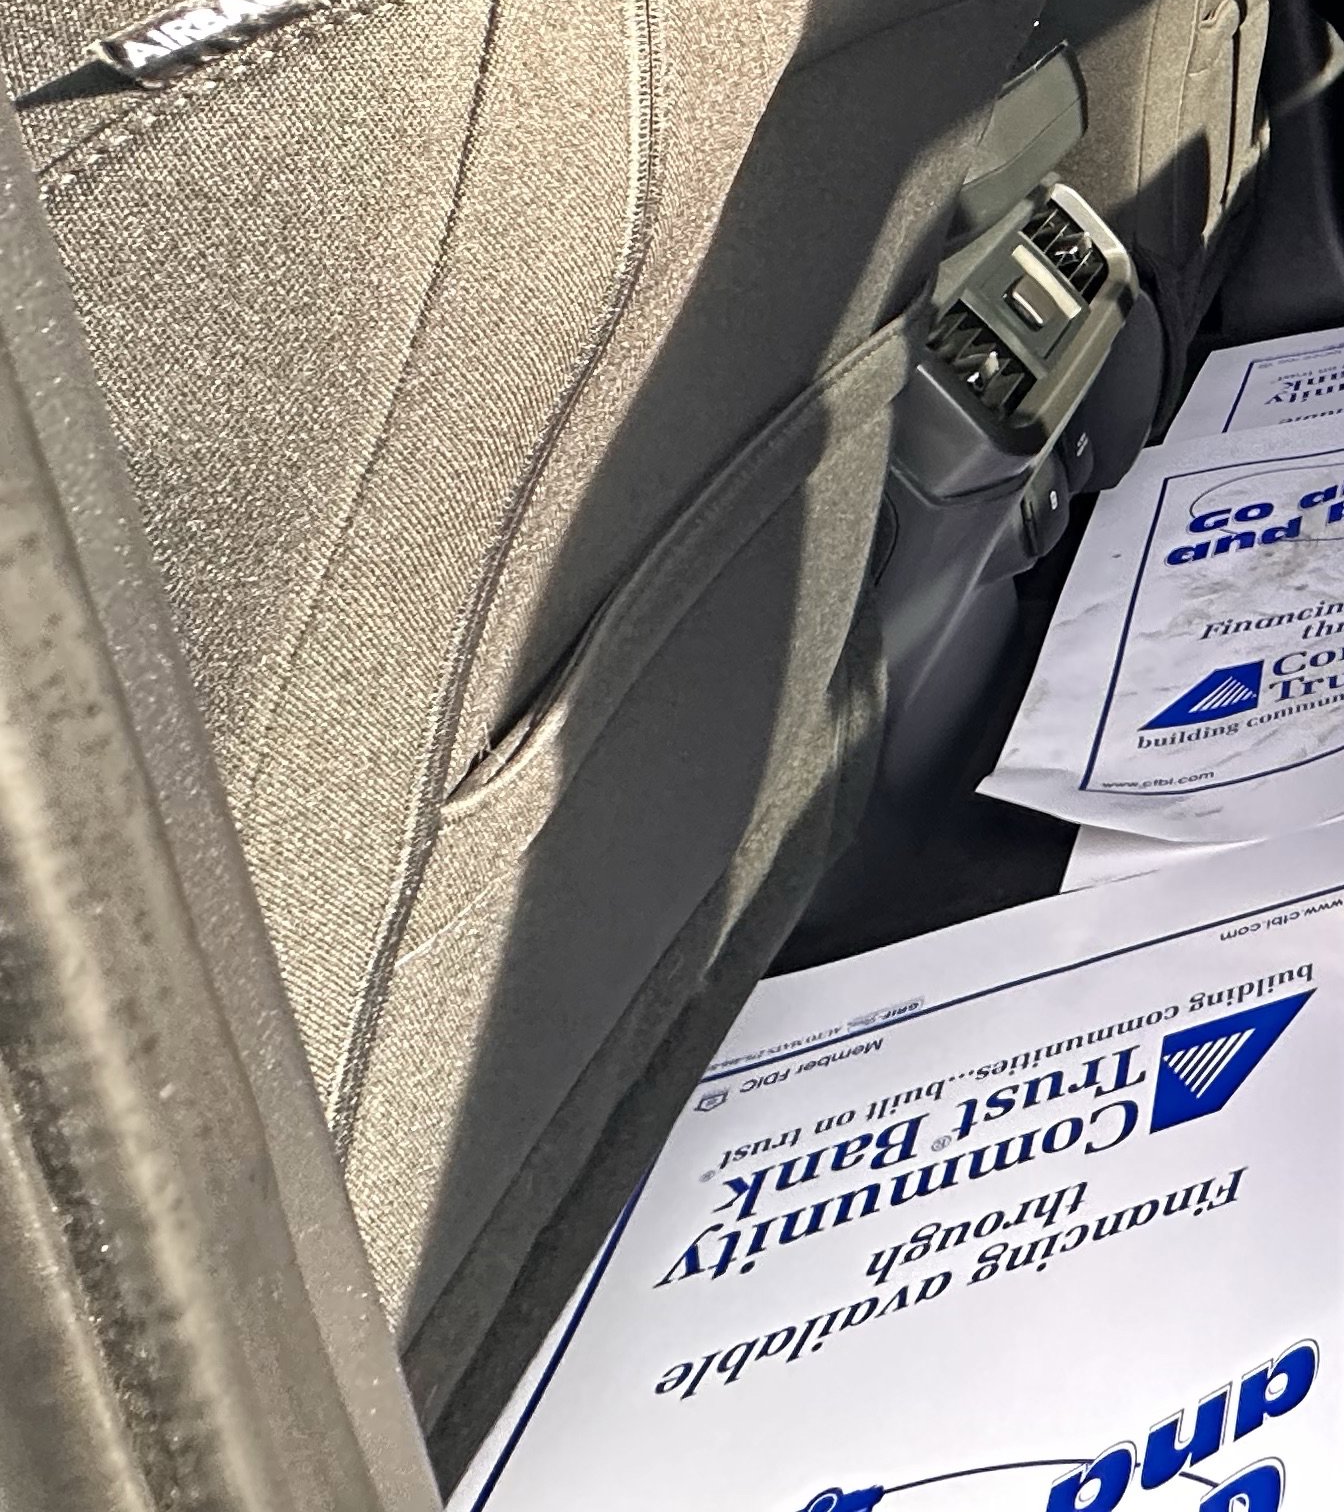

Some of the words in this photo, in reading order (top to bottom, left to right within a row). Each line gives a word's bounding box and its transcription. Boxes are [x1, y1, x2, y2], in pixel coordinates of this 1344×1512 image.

[1164, 515, 1303, 567] and
[1187, 502, 1275, 535] Go
[1136, 720, 1241, 751] building
[1219, 897, 1344, 942] www.ctbi.com
[1189, 961, 1316, 1014] building
[738, 1067, 792, 1094] FDIC
[794, 1037, 885, 1076] Member
[814, 1108, 857, 1134] on
[711, 1111, 933, 1223] Bank
[652, 1098, 1142, 1292] Community
[864, 1180, 1090, 1288] through
[965, 1165, 1251, 1288] Financing
[653, 1268, 953, 1402] available
